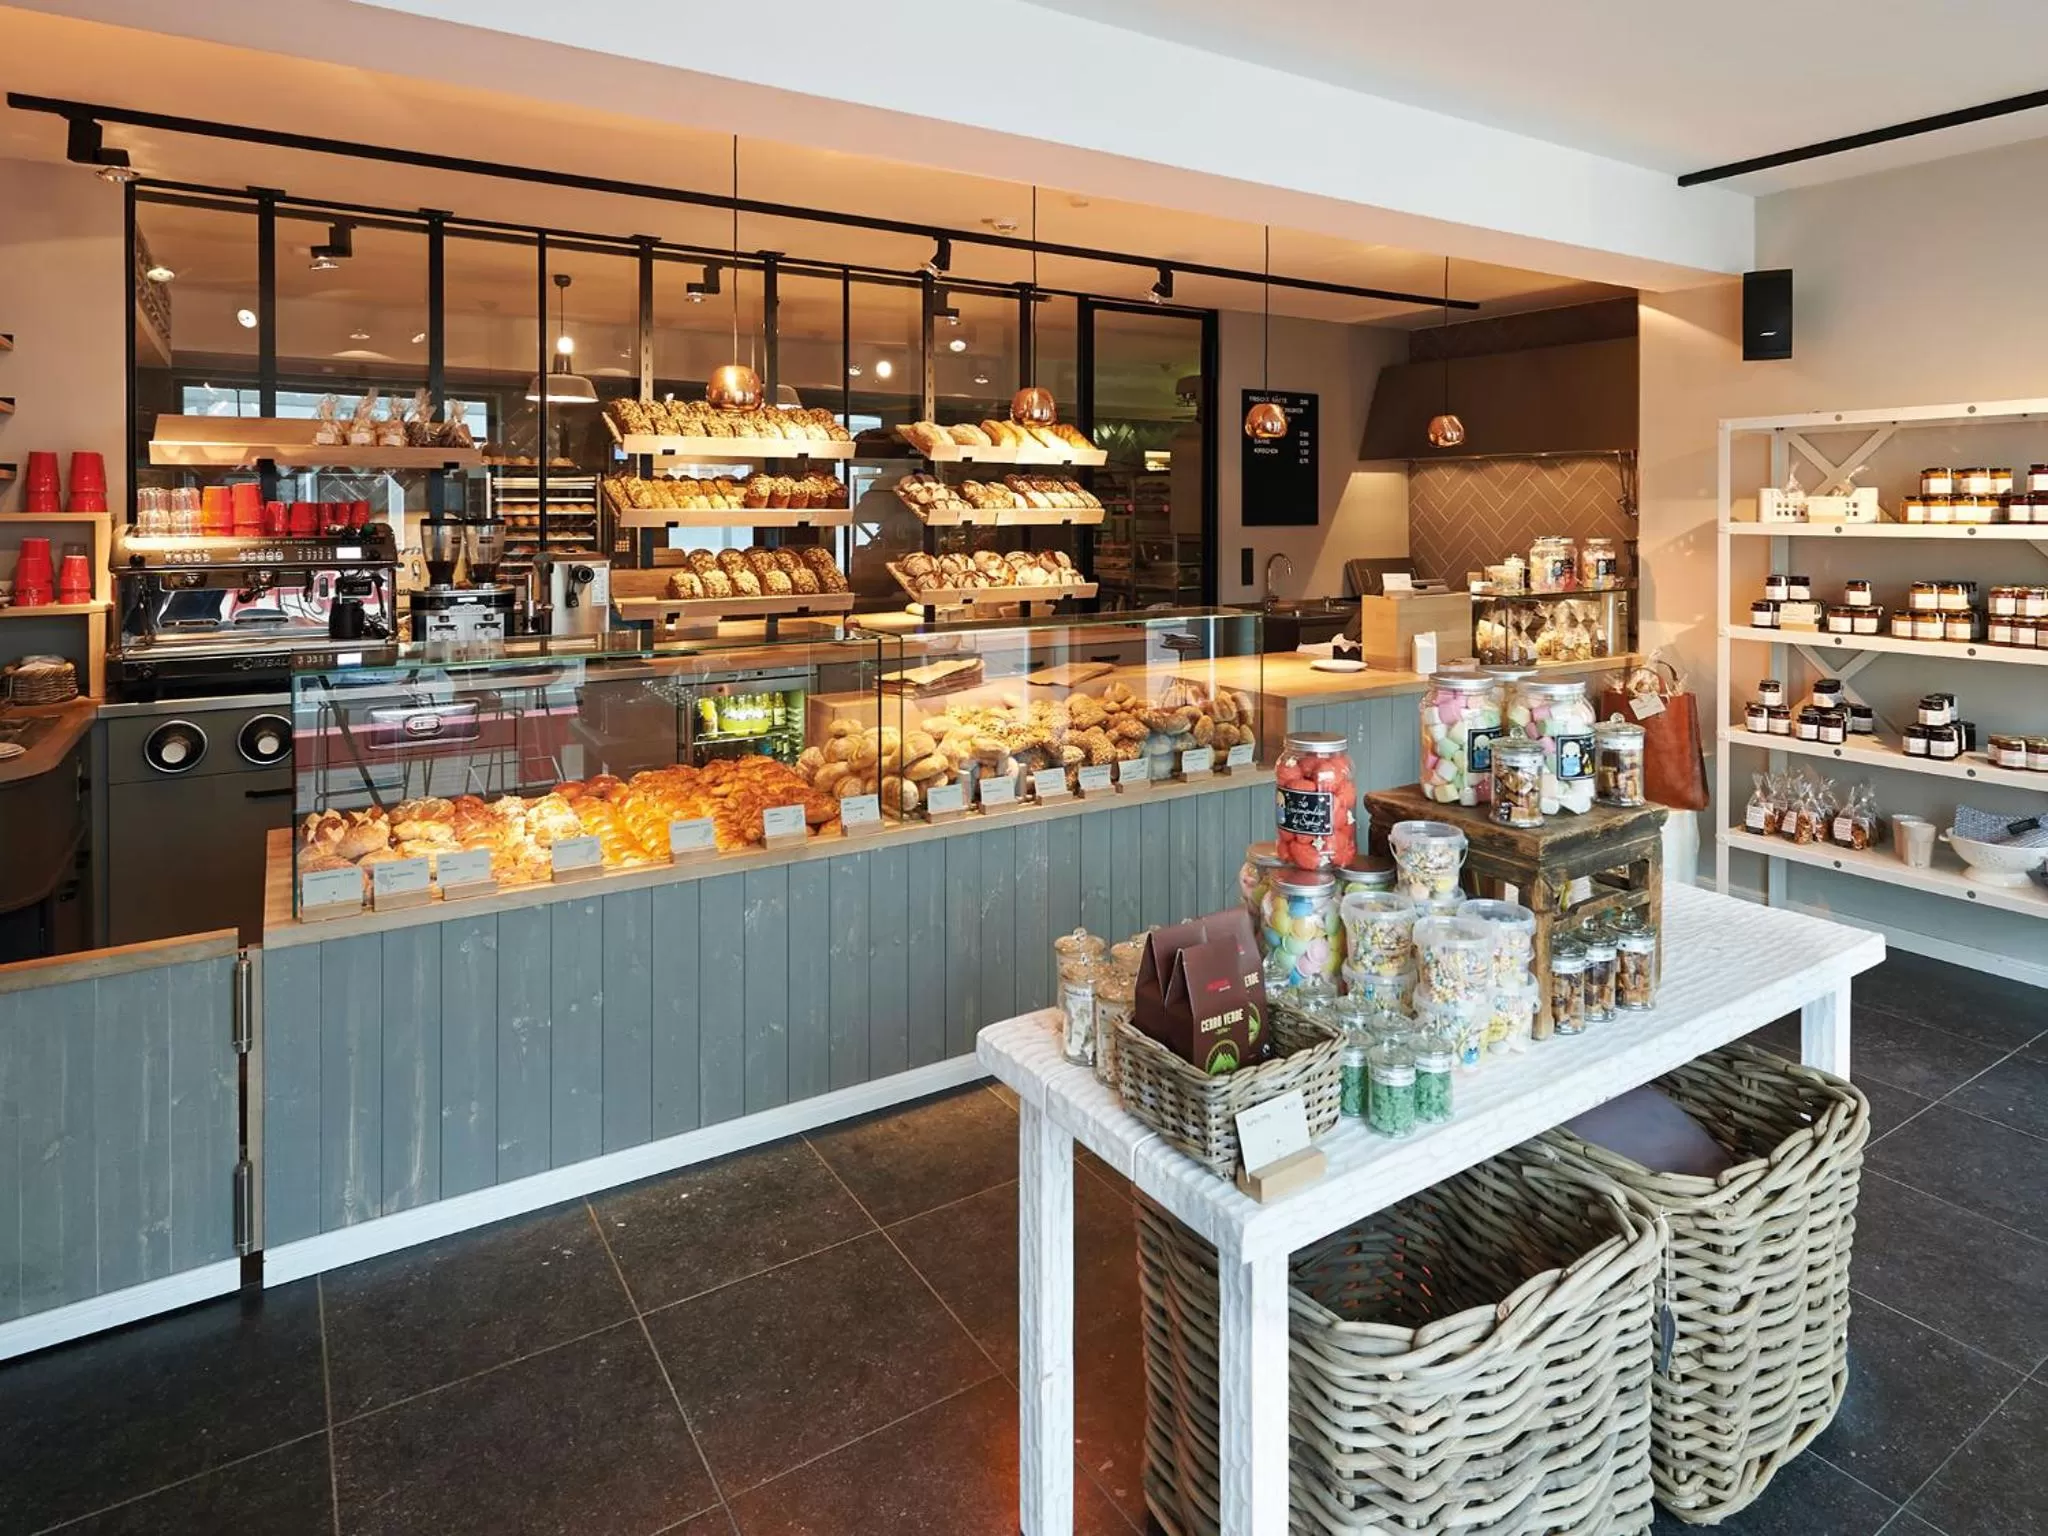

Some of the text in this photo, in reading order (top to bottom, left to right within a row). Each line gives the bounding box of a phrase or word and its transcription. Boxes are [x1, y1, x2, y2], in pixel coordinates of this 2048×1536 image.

[1244, 972, 1260, 988] ERDE
[1201, 1015, 1223, 1033] CERRO
[1223, 1008, 1244, 1025] VERDE
